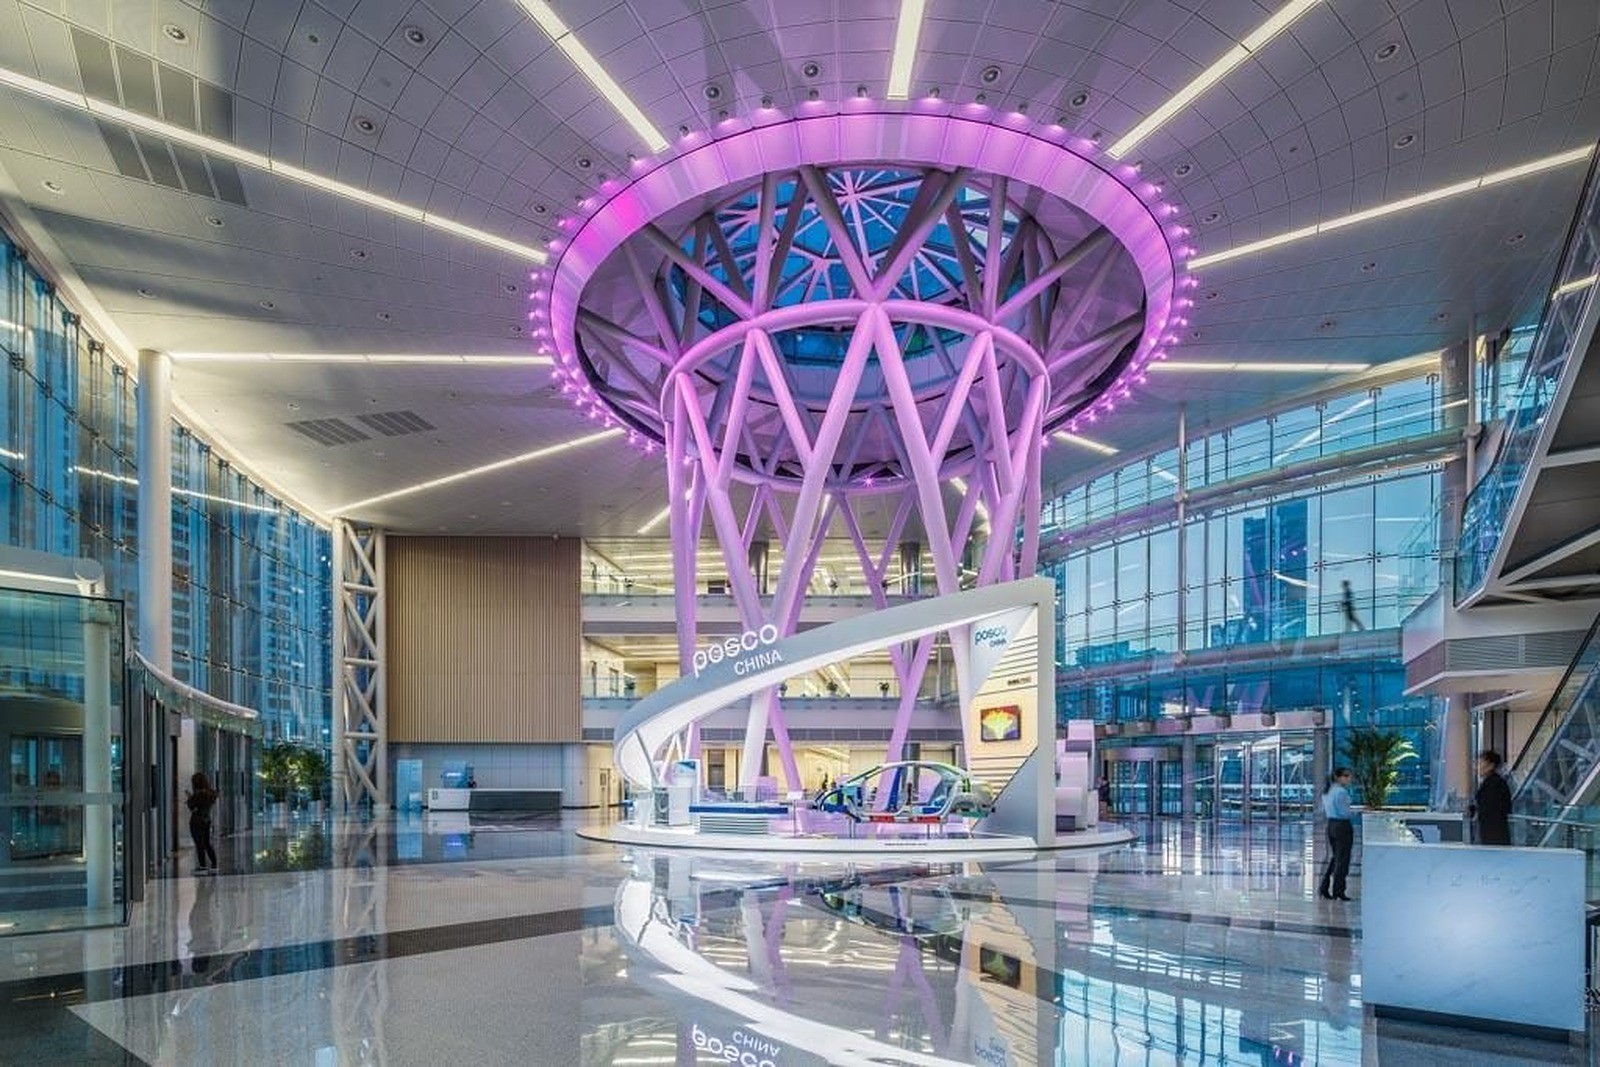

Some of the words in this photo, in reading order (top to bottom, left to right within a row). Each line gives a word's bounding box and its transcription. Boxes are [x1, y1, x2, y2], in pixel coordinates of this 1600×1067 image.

[975, 626, 1007, 646] posco
[693, 624, 777, 678] posco
[734, 649, 782, 675] CHINA
